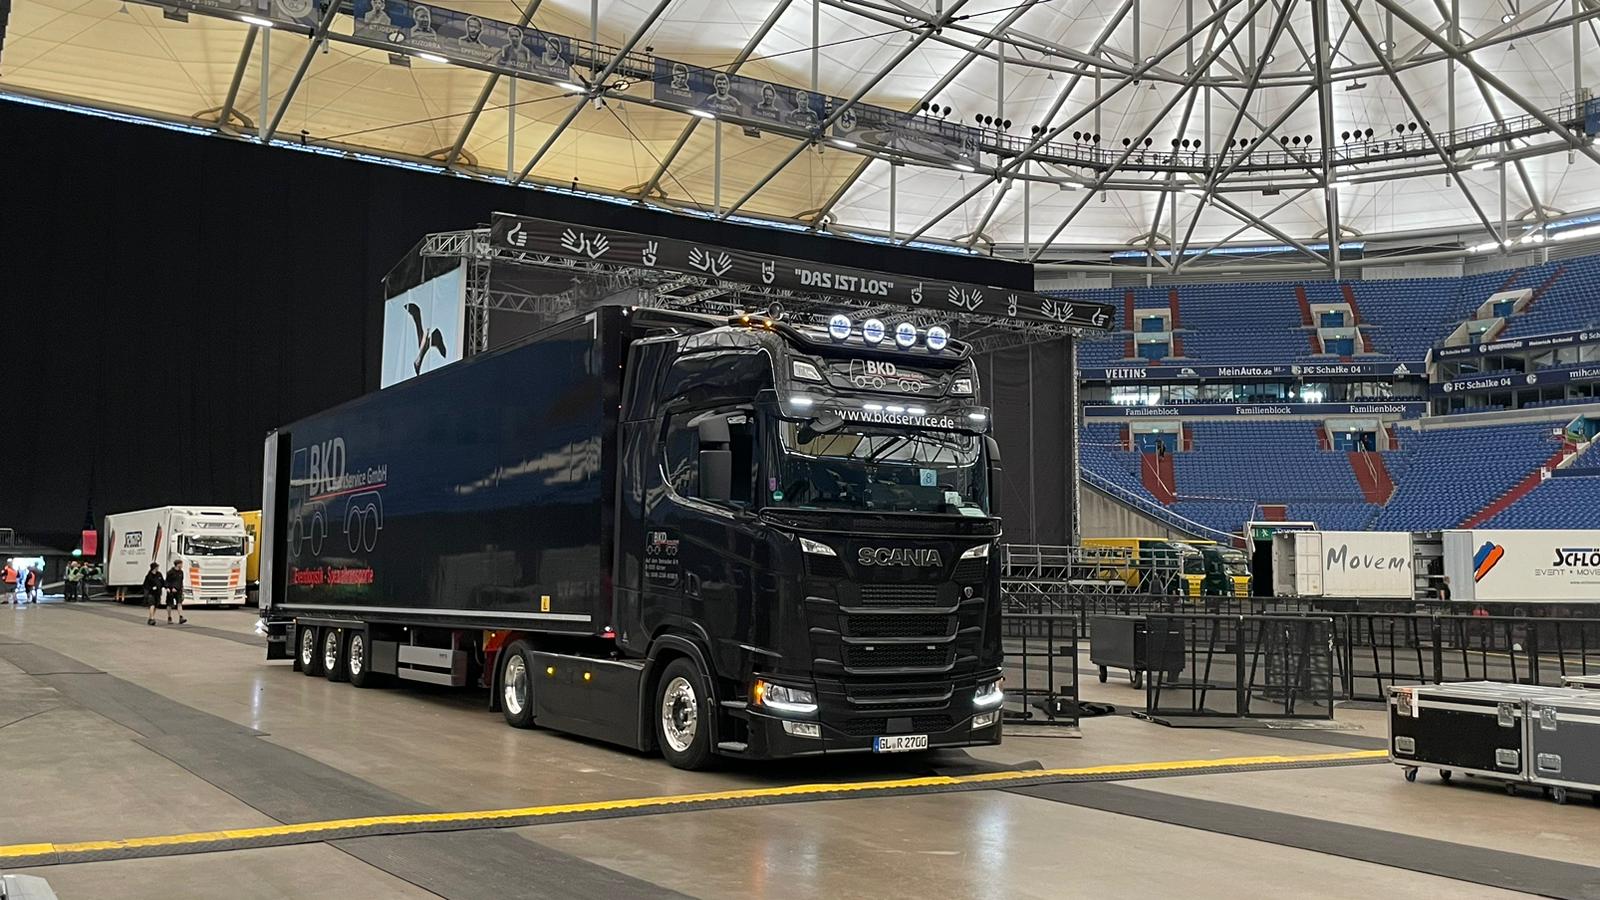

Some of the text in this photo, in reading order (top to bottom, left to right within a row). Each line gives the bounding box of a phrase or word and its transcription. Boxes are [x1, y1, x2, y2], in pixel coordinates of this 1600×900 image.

[795, 269, 894, 296] "DAS IST LOS"
[866, 360, 897, 376] BKD
[1105, 368, 1147, 379] VELTINS
[1218, 367, 1272, 376] MeinAuto.de
[1454, 378, 1511, 391] FC Schalke 04
[1125, 408, 1179, 416] Familienblock
[1235, 406, 1291, 415] Familienblock
[1350, 405, 1406, 414] Familienblock
[834, 410, 954, 429] www.bkdservice.de
[309, 437, 346, 496] BKD
[367, 464, 387, 484] GmbH
[858, 547, 943, 567] SCANIA
[1327, 543, 1411, 572] Movem
[1535, 568, 1565, 577] EVENT
[880, 736, 927, 750] GL R 2700
